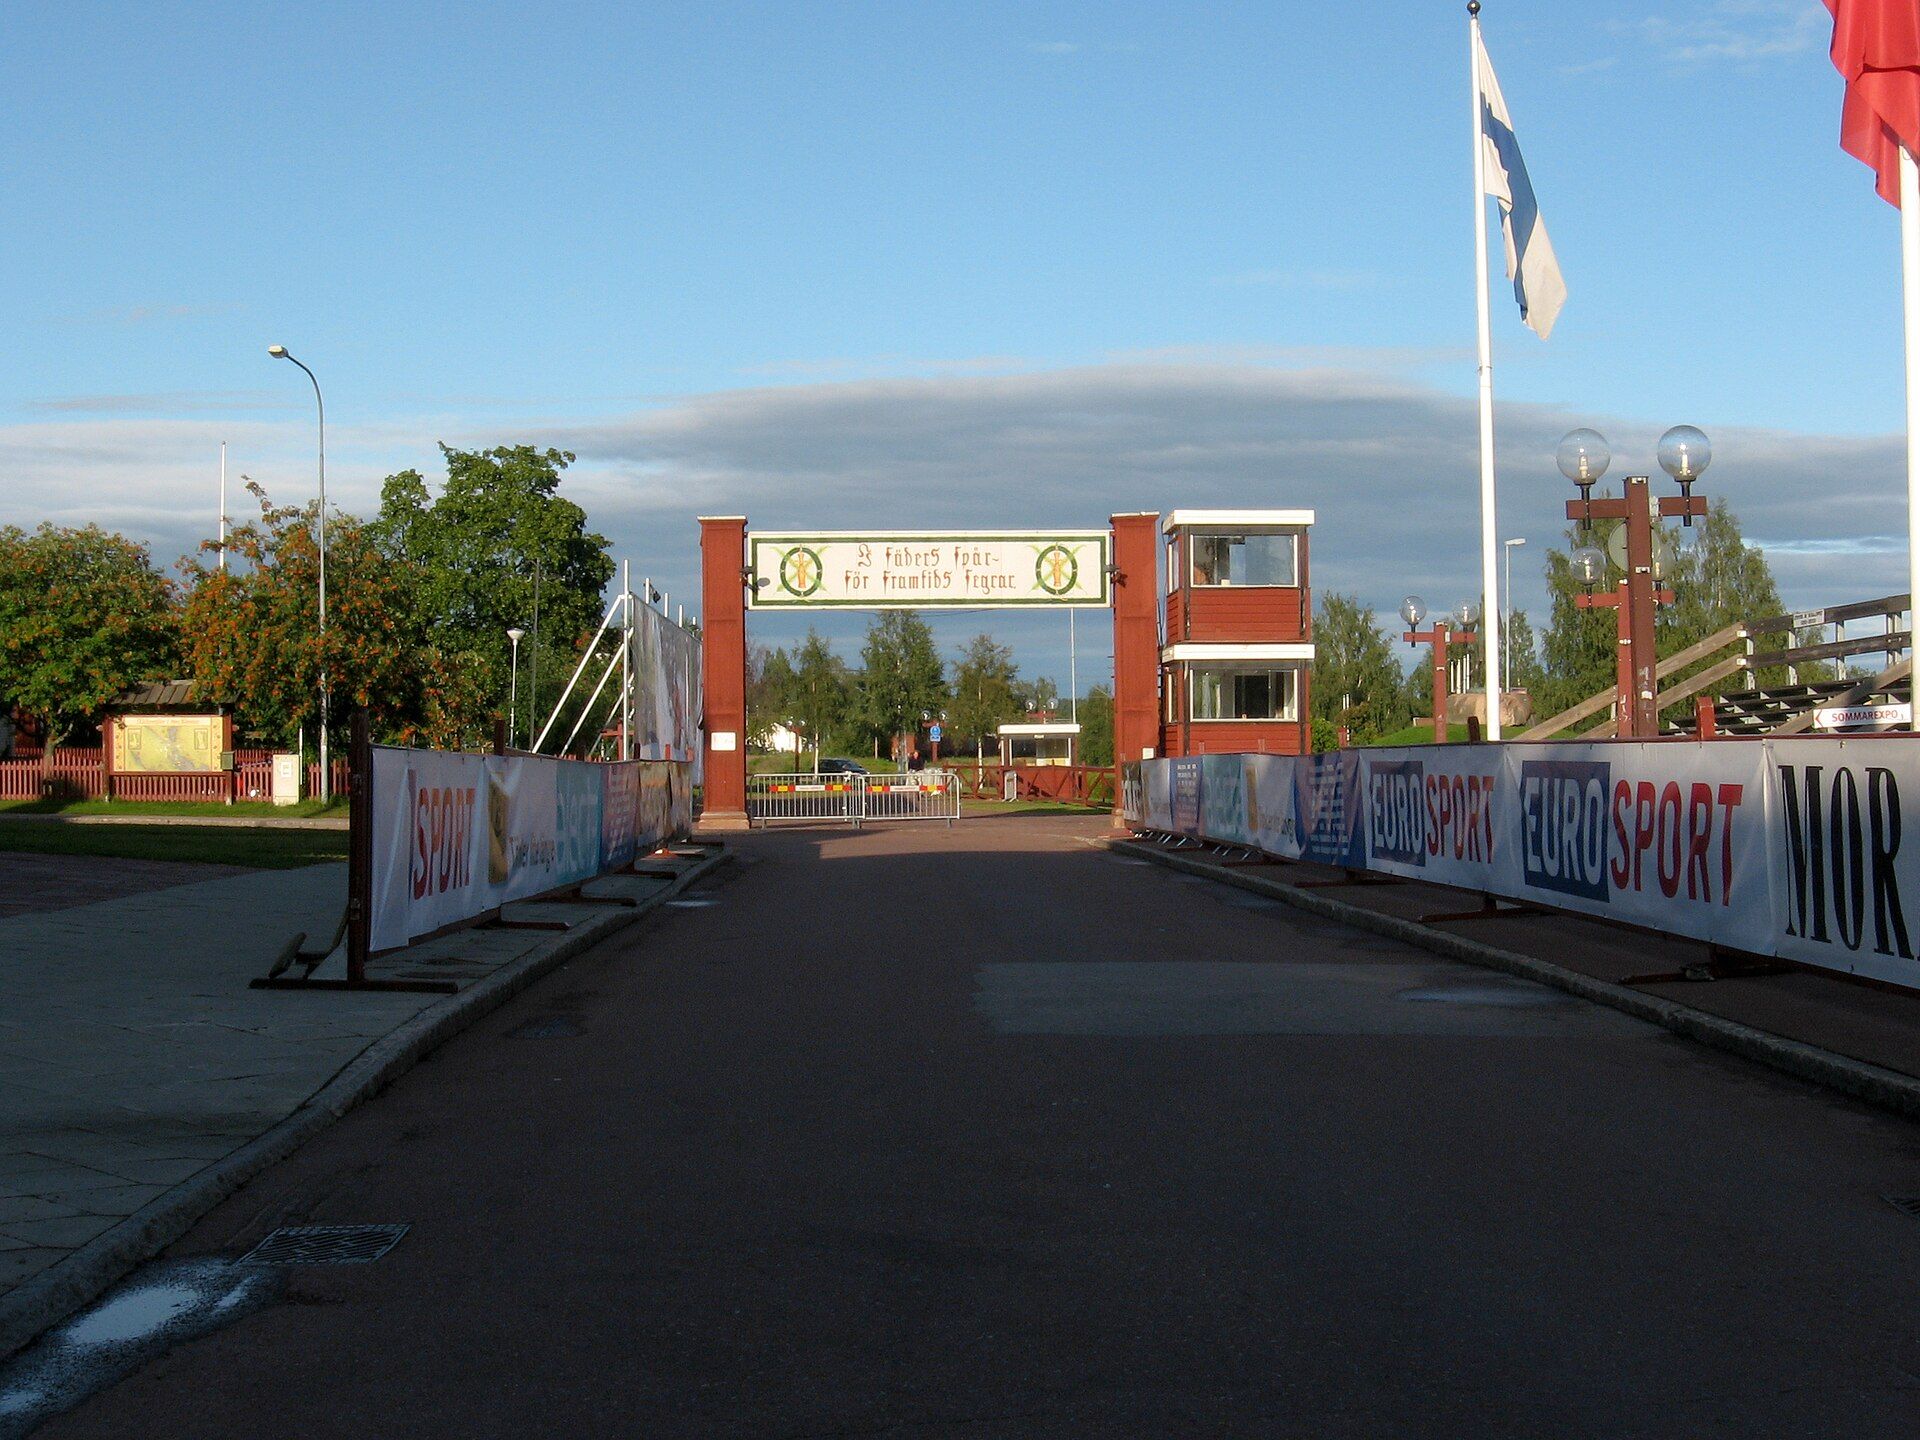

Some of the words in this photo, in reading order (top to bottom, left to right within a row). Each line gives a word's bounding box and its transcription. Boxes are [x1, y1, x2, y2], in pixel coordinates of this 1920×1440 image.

[885, 547, 941, 570] fäders
[844, 569, 869, 594] för
[882, 569, 953, 594] framtids
[1831, 709, 1898, 724] SOMMAREXPO
[1778, 764, 1920, 961] MOR
